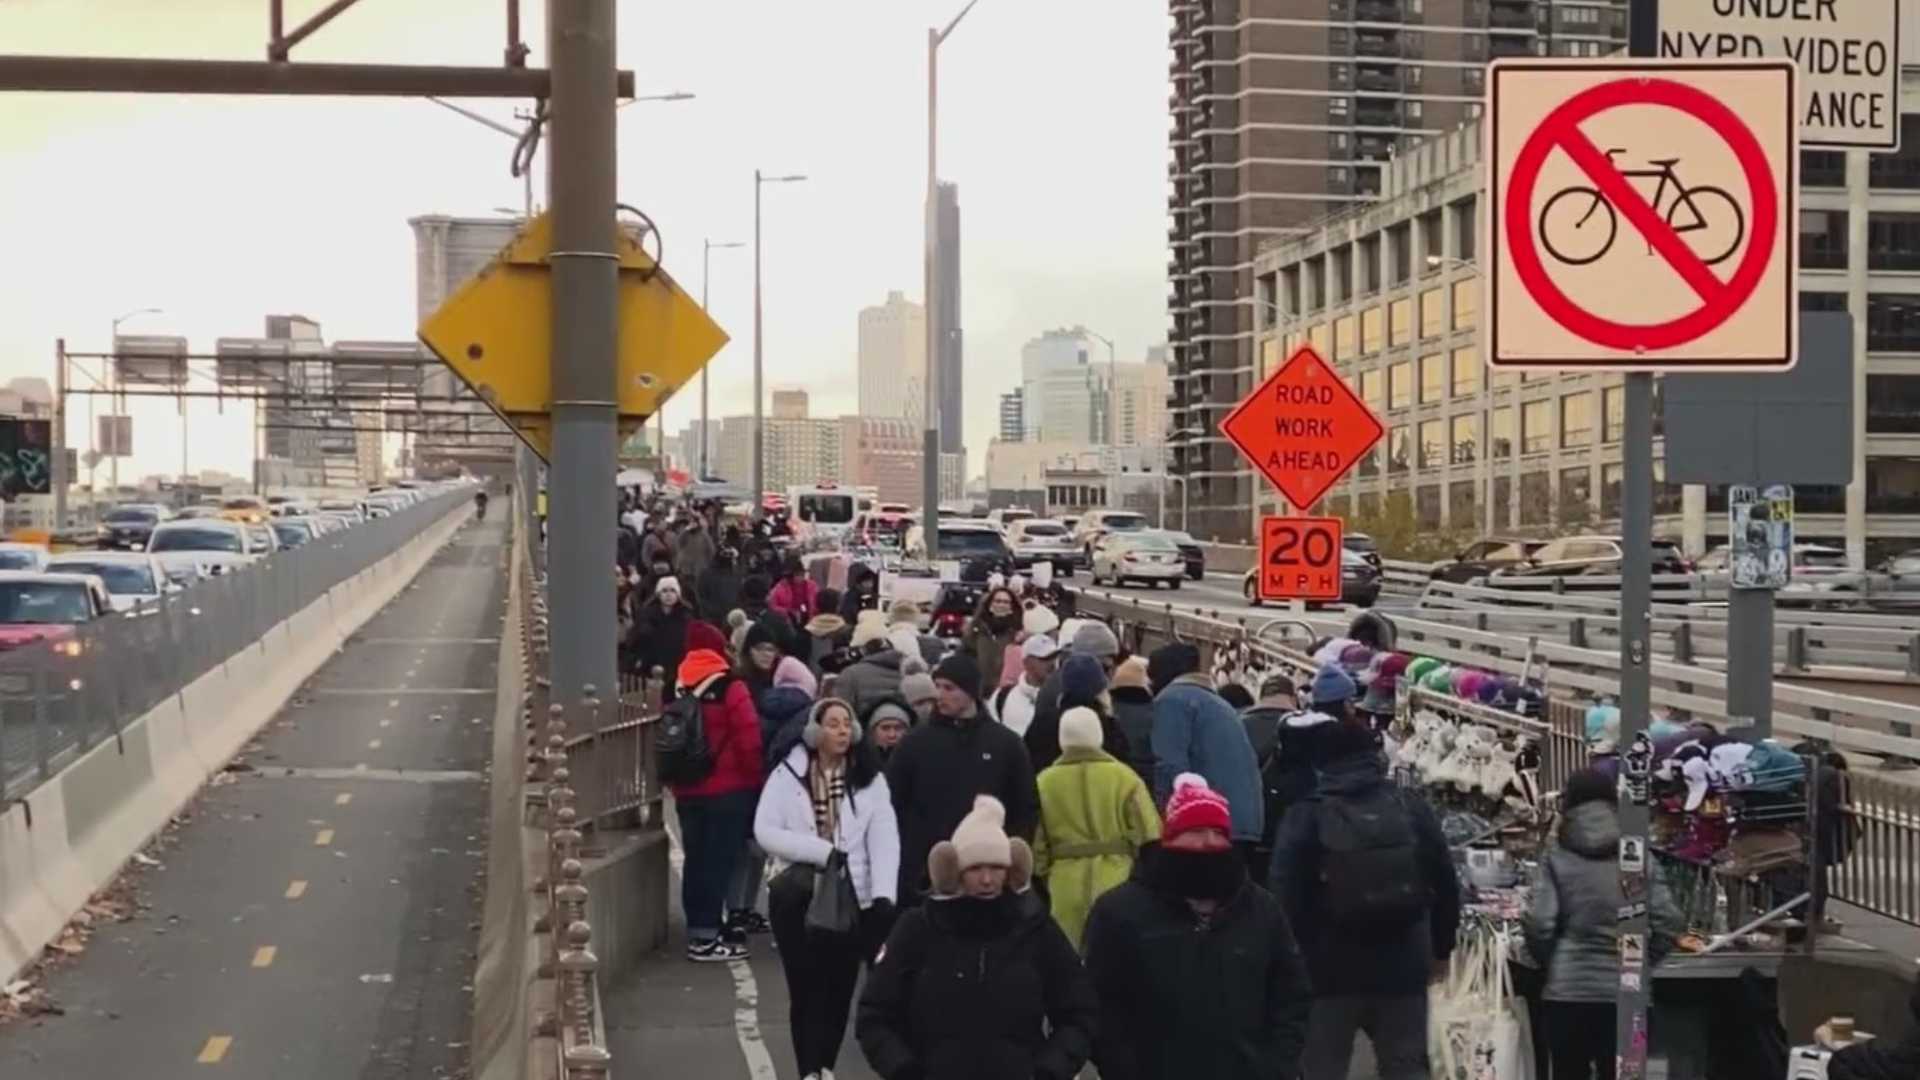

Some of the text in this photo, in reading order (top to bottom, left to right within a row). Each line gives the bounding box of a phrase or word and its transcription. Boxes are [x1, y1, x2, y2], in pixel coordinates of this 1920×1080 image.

[1783, 36, 1887, 76] VIDEO
[1800, 91, 1885, 129] ANCE
[1276, 384, 1333, 405] ROAD
[1275, 417, 1333, 438] WORK
[1267, 451, 1340, 471] AHEAD
[1268, 526, 1334, 568] 20
[1270, 574, 1333, 589] MPH
